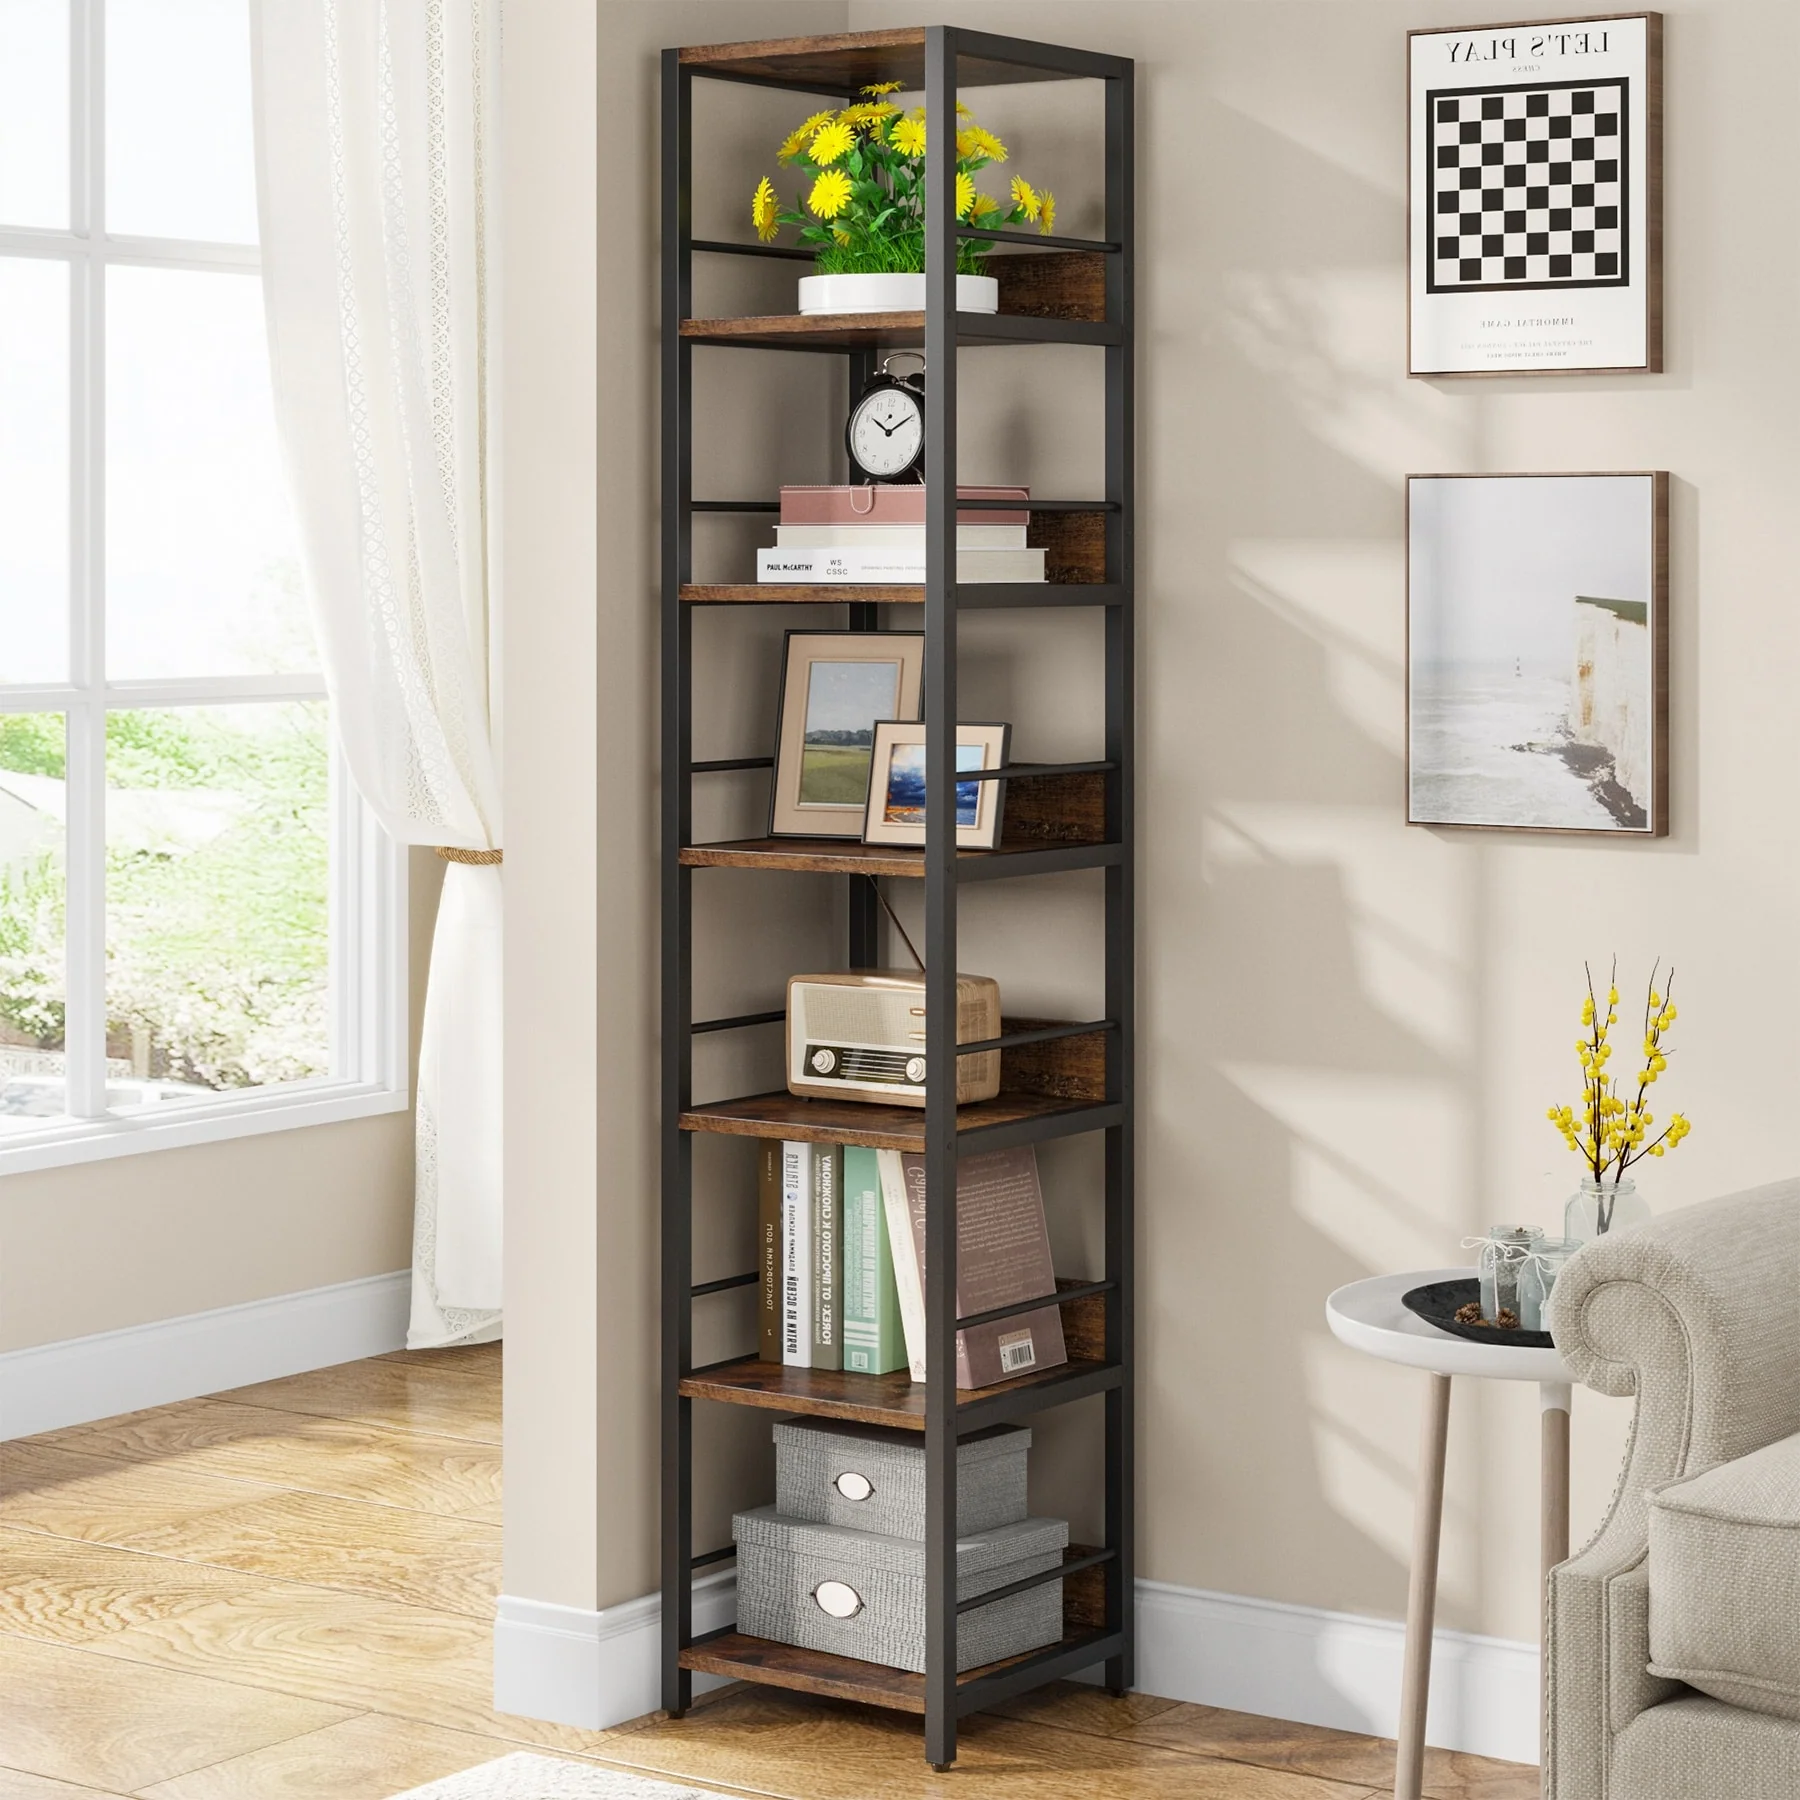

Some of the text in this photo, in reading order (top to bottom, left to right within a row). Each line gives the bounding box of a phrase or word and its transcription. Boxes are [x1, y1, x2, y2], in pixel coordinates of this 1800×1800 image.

[876, 402, 883, 412] 11
[887, 398, 896, 407] 12
[767, 563, 813, 572] PAUL McCARTHY
[826, 568, 848, 576] CSSC
